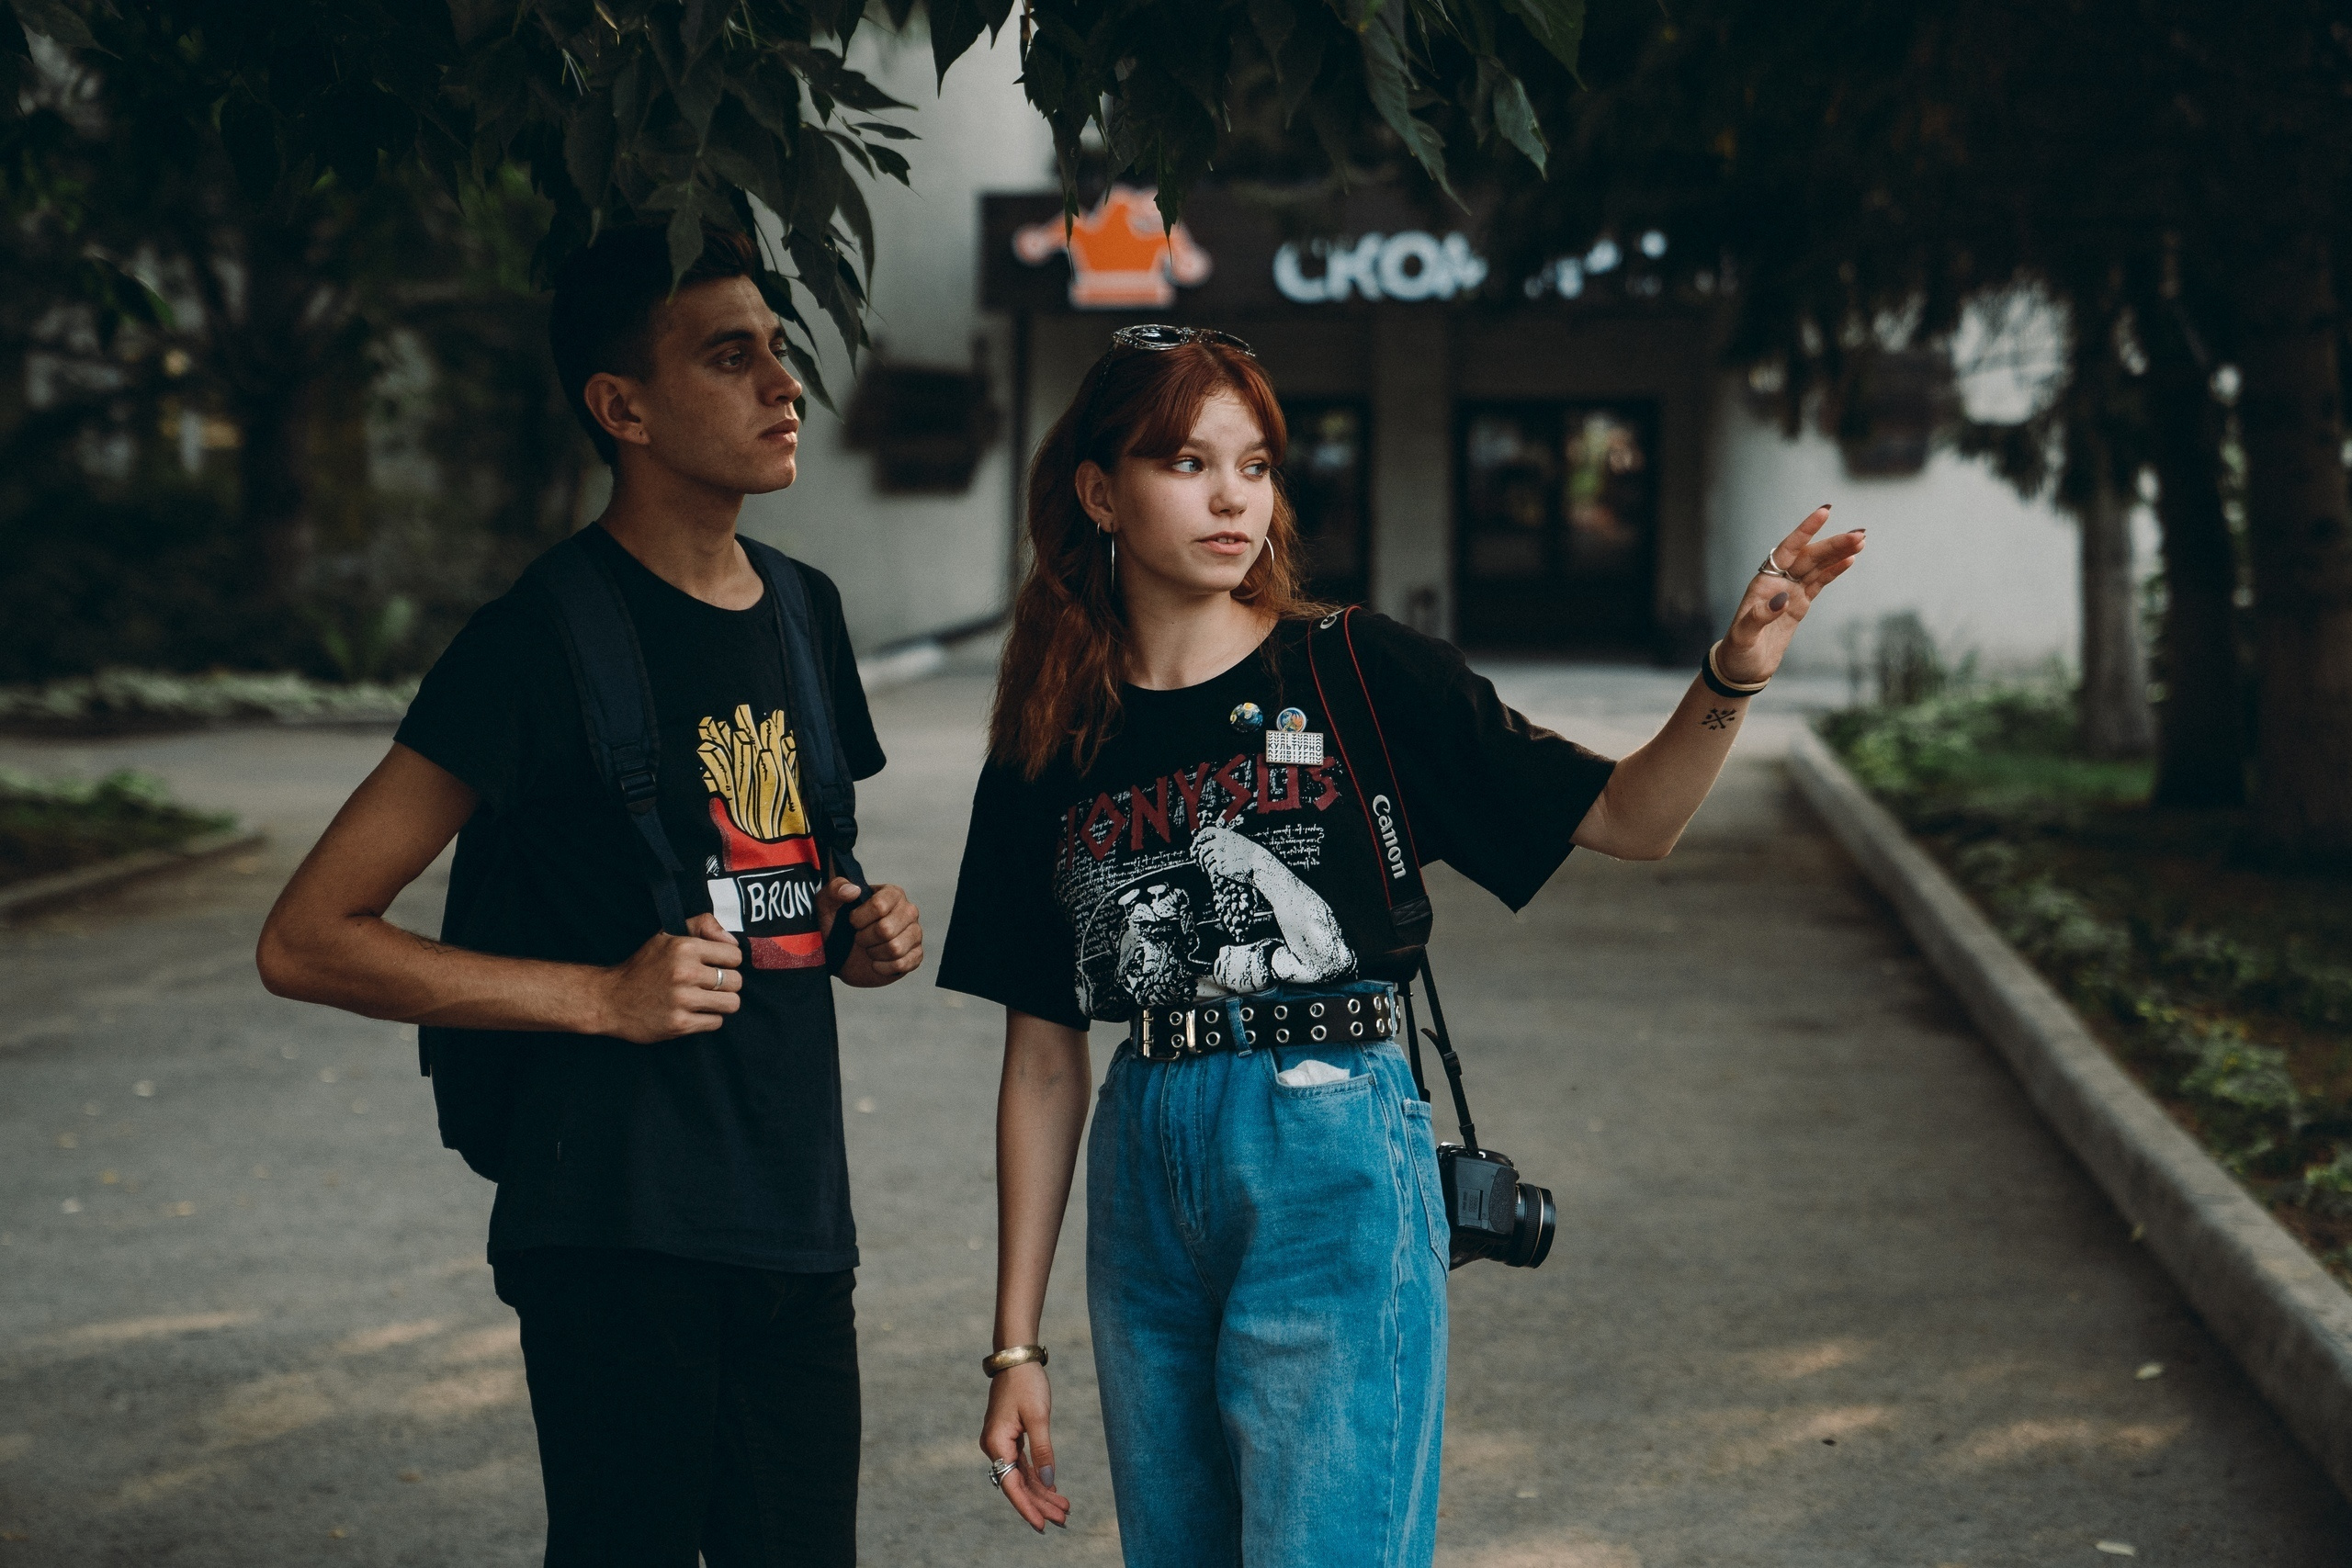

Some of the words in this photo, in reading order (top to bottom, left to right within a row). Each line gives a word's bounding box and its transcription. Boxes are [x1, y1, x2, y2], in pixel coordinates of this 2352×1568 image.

[1268, 742, 1322, 751] КУЛЬТУРНО
[1057, 753, 1340, 870] IONYSUS
[1373, 795, 1407, 879] Canon
